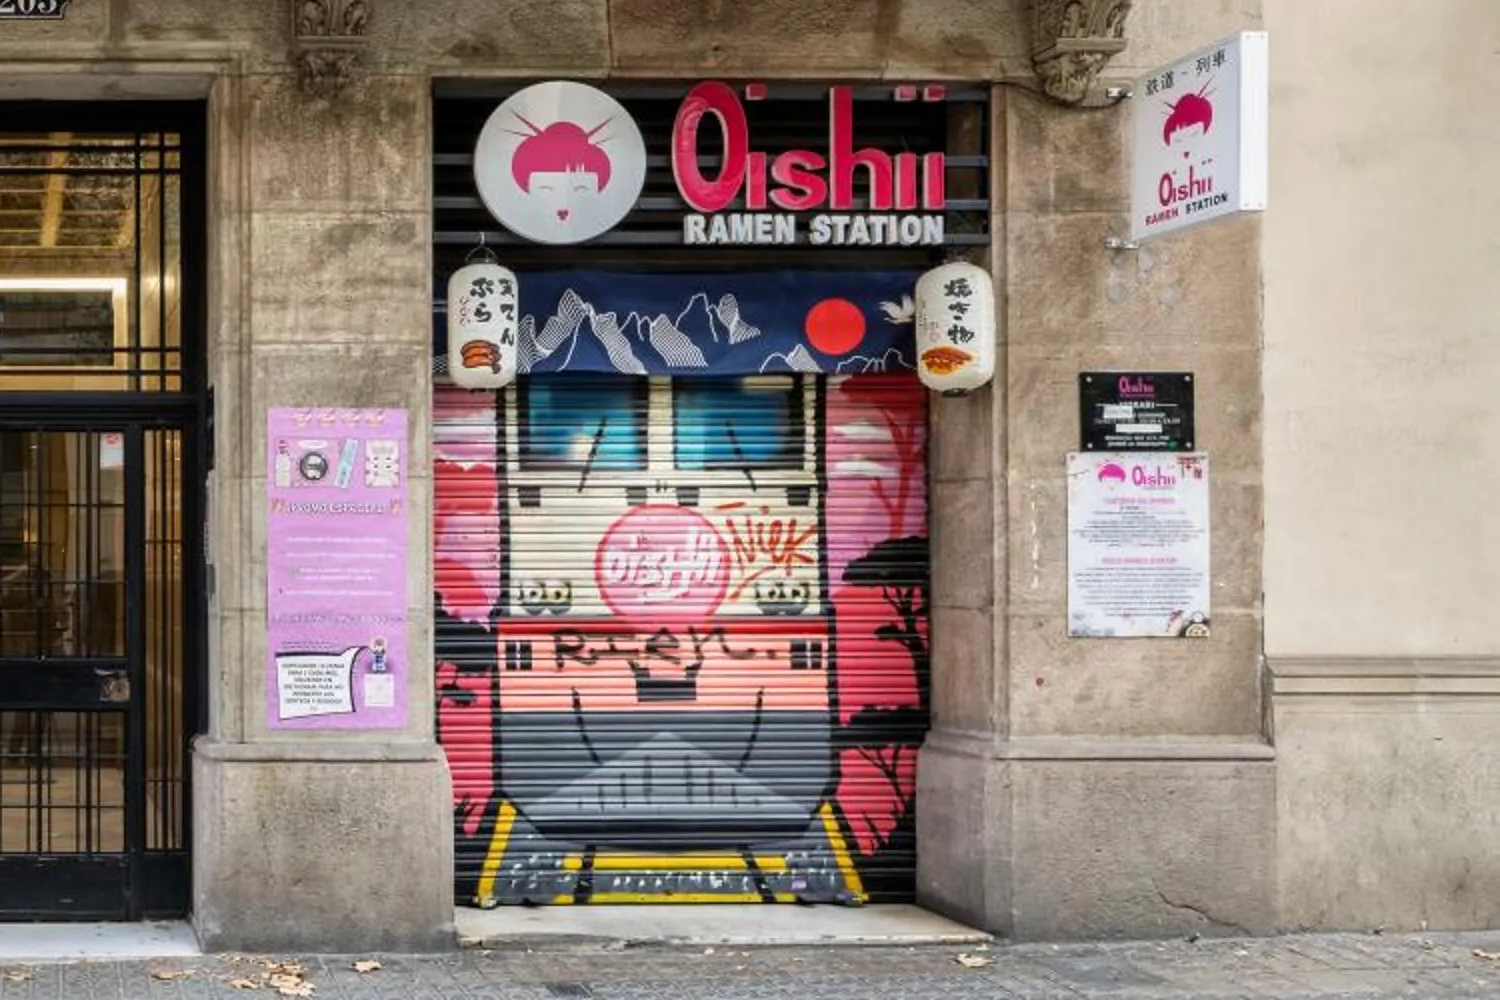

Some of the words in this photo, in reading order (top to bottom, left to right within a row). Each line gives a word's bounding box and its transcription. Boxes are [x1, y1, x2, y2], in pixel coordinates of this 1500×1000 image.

[671, 81, 945, 212] Oishii
[1158, 157, 1214, 207] Oishii
[683, 214, 796, 245] RAMEN
[809, 214, 945, 245] STATION
[1145, 207, 1179, 226] RAMEN
[1185, 193, 1229, 215] STATION
